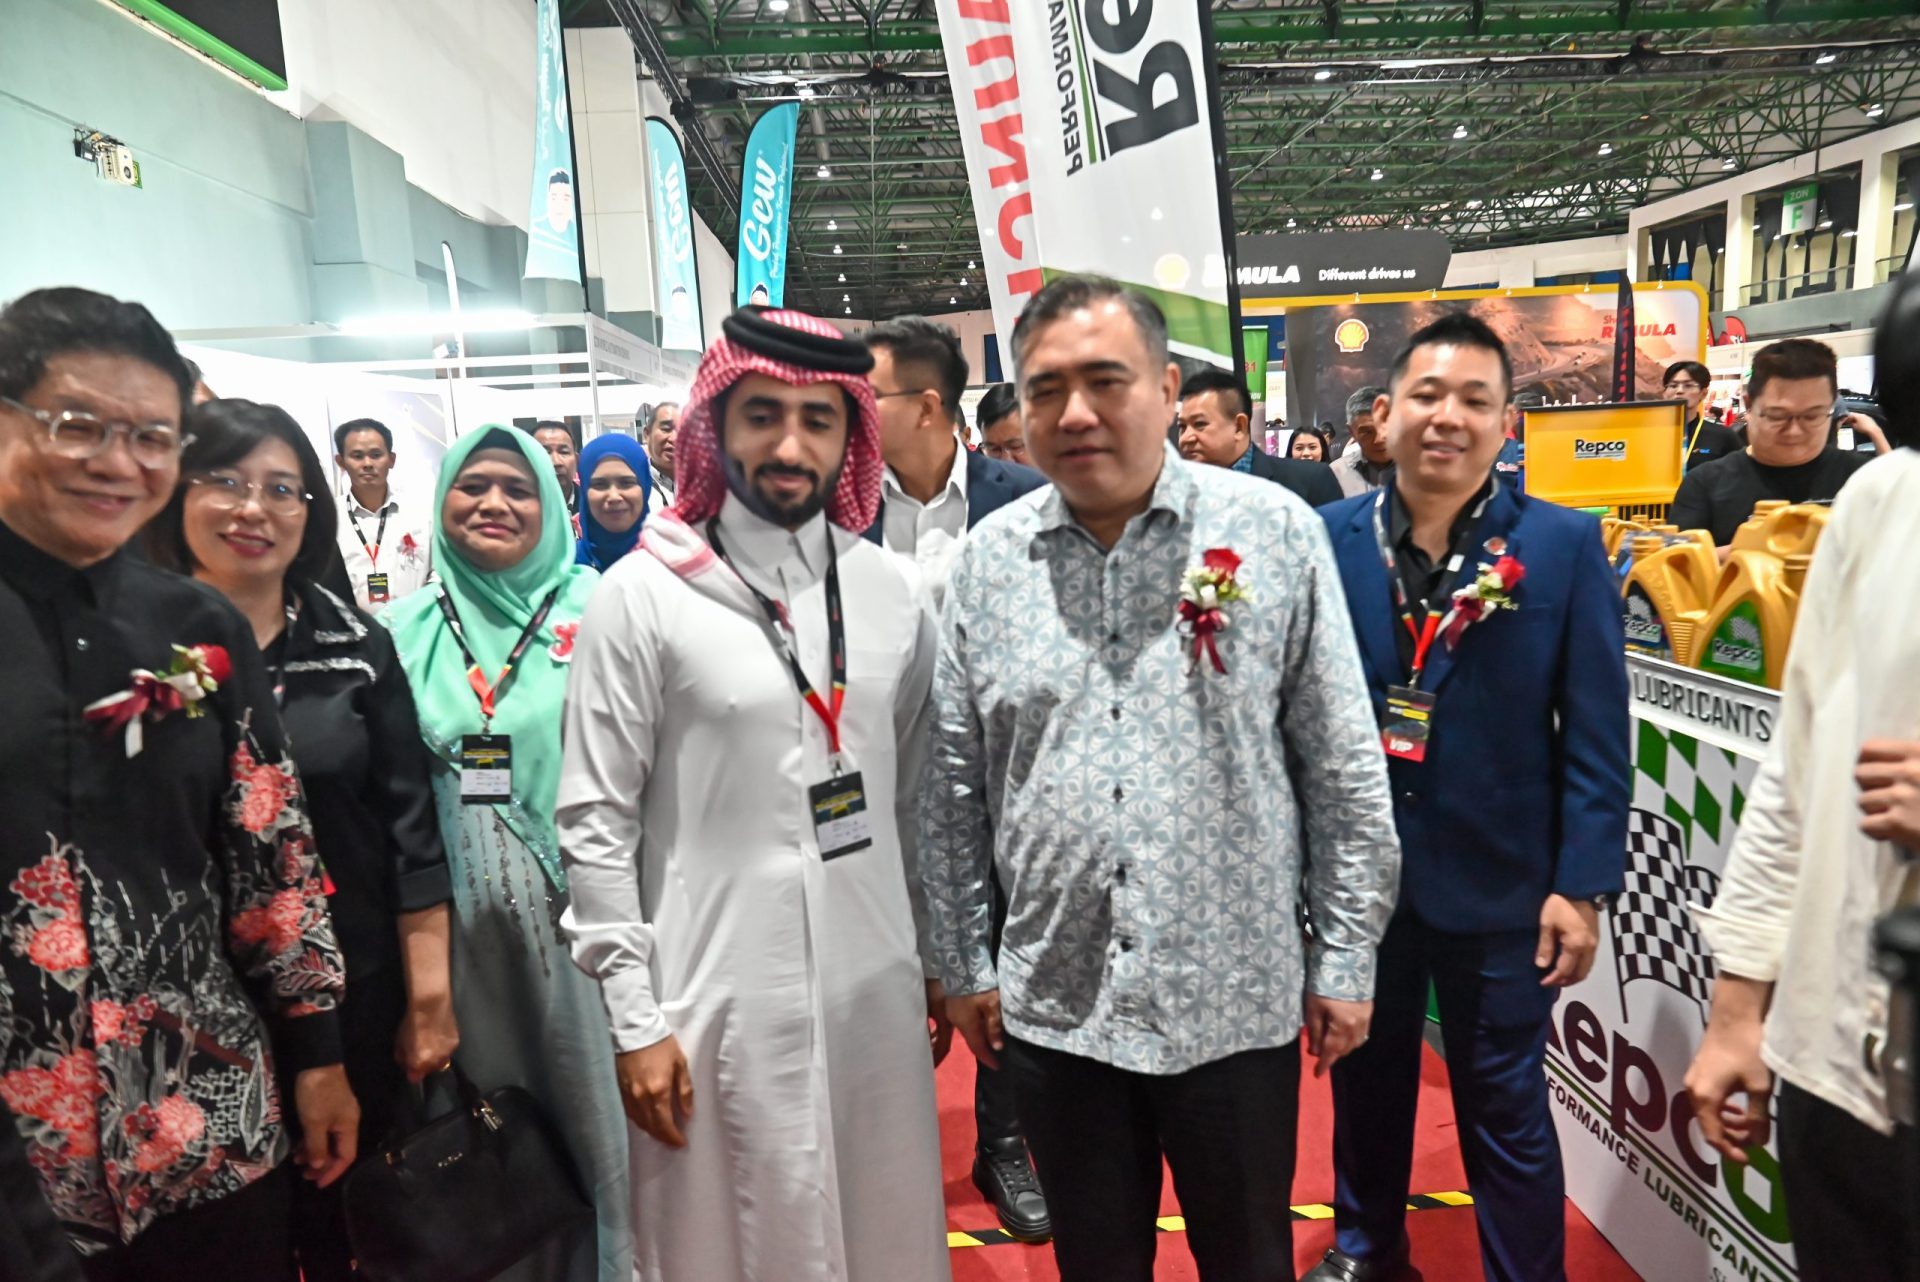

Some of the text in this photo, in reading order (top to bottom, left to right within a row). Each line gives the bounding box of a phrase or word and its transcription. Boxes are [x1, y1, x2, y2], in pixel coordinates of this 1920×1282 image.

[1791, 205, 1804, 230] F
[1318, 266, 1417, 281] Different drives us
[1601, 323, 1677, 339] RULA
[1575, 438, 1626, 456] Repco
[1714, 640, 1760, 662] Repco
[1633, 668, 1772, 742] LUBRICANTS
